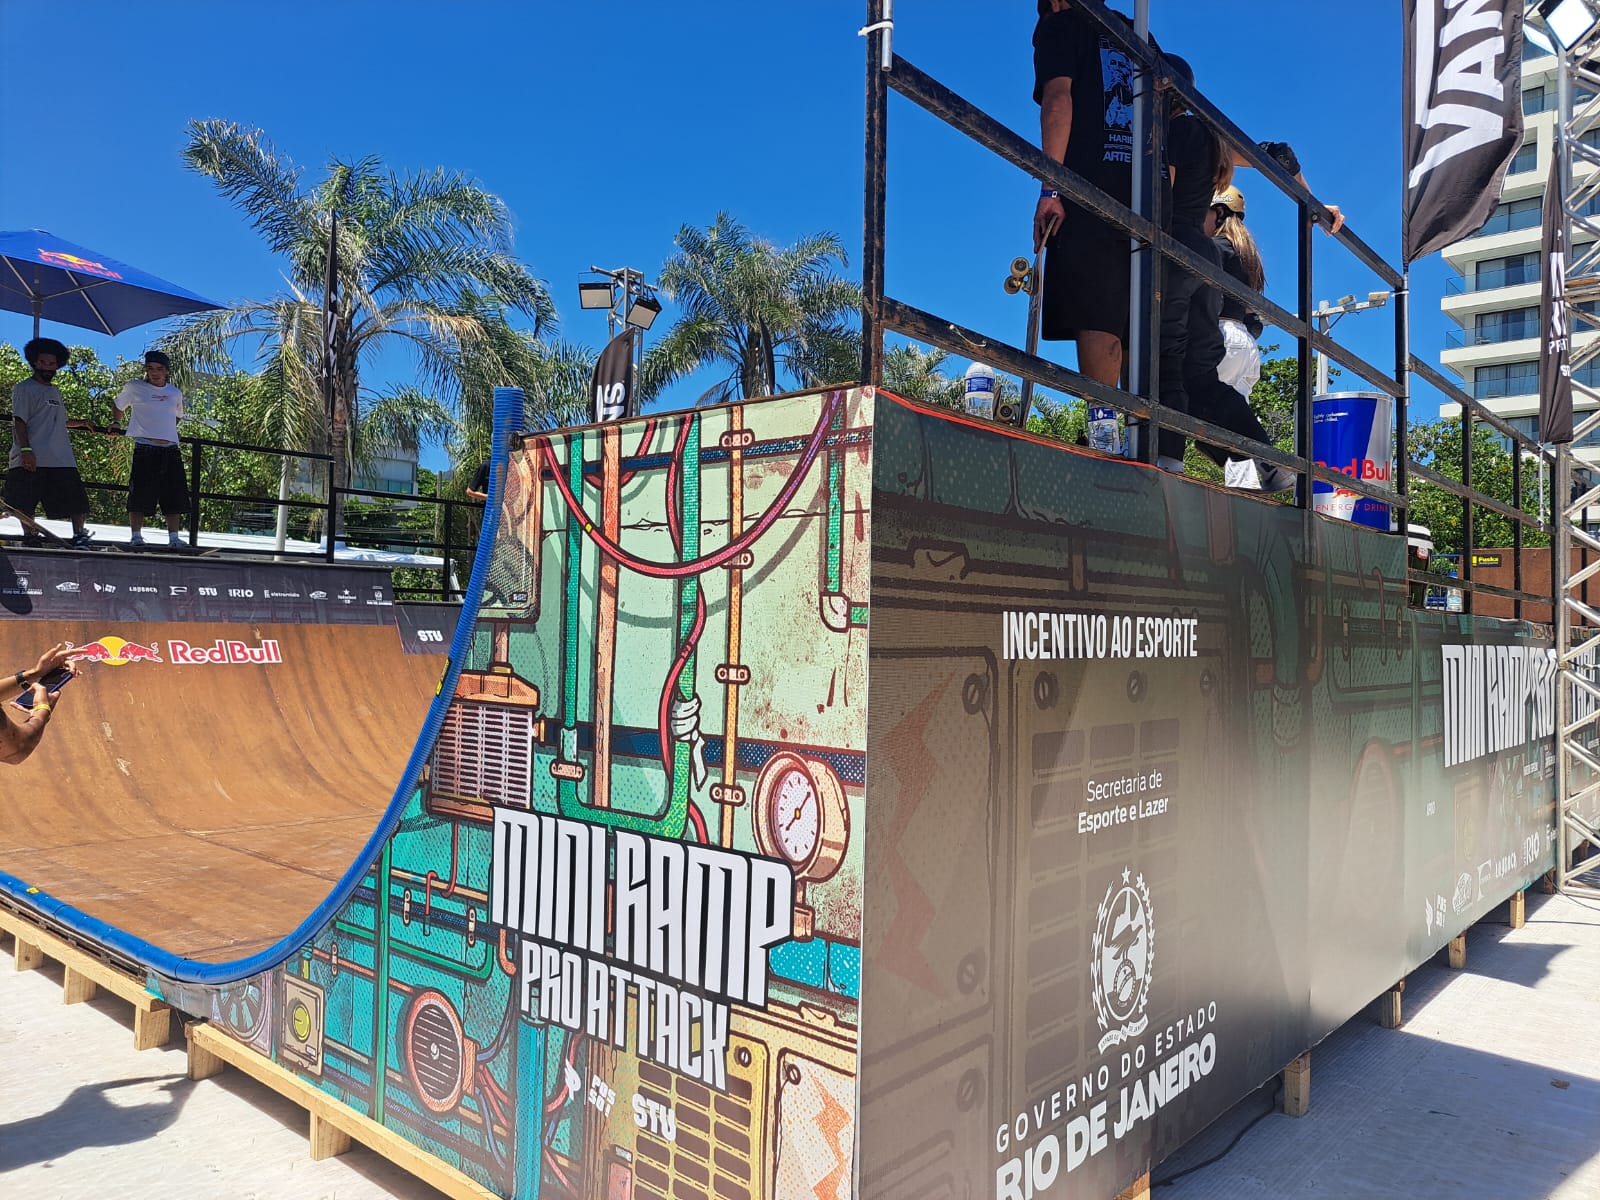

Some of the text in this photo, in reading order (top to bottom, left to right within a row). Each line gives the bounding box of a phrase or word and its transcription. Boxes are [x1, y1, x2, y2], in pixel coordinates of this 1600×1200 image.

[1361, 459, 1392, 481] Bull
[1315, 503, 1361, 513] ENERGY
[198, 587, 218, 597] STU
[168, 640, 282, 664] Red Bull
[417, 629, 444, 642] STU
[1002, 611, 1198, 660] INCENTIVO AO ESPORTE
[1086, 768, 1163, 802] Secretaria de
[1078, 797, 1169, 834] Esporte e Lazer
[492, 806, 792, 1008] MINI RAMP
[520, 939, 731, 1091] PRO ATTACK
[996, 1065, 1109, 1153] GOVERNO
[1121, 1044, 1145, 1078] DO
[1155, 1000, 1217, 1057] ESTADO
[631, 1092, 677, 1141] STU
[996, 1134, 1060, 1200] RIO
[1067, 1100, 1108, 1173] DE
[1113, 1032, 1217, 1140] JANEIRO
